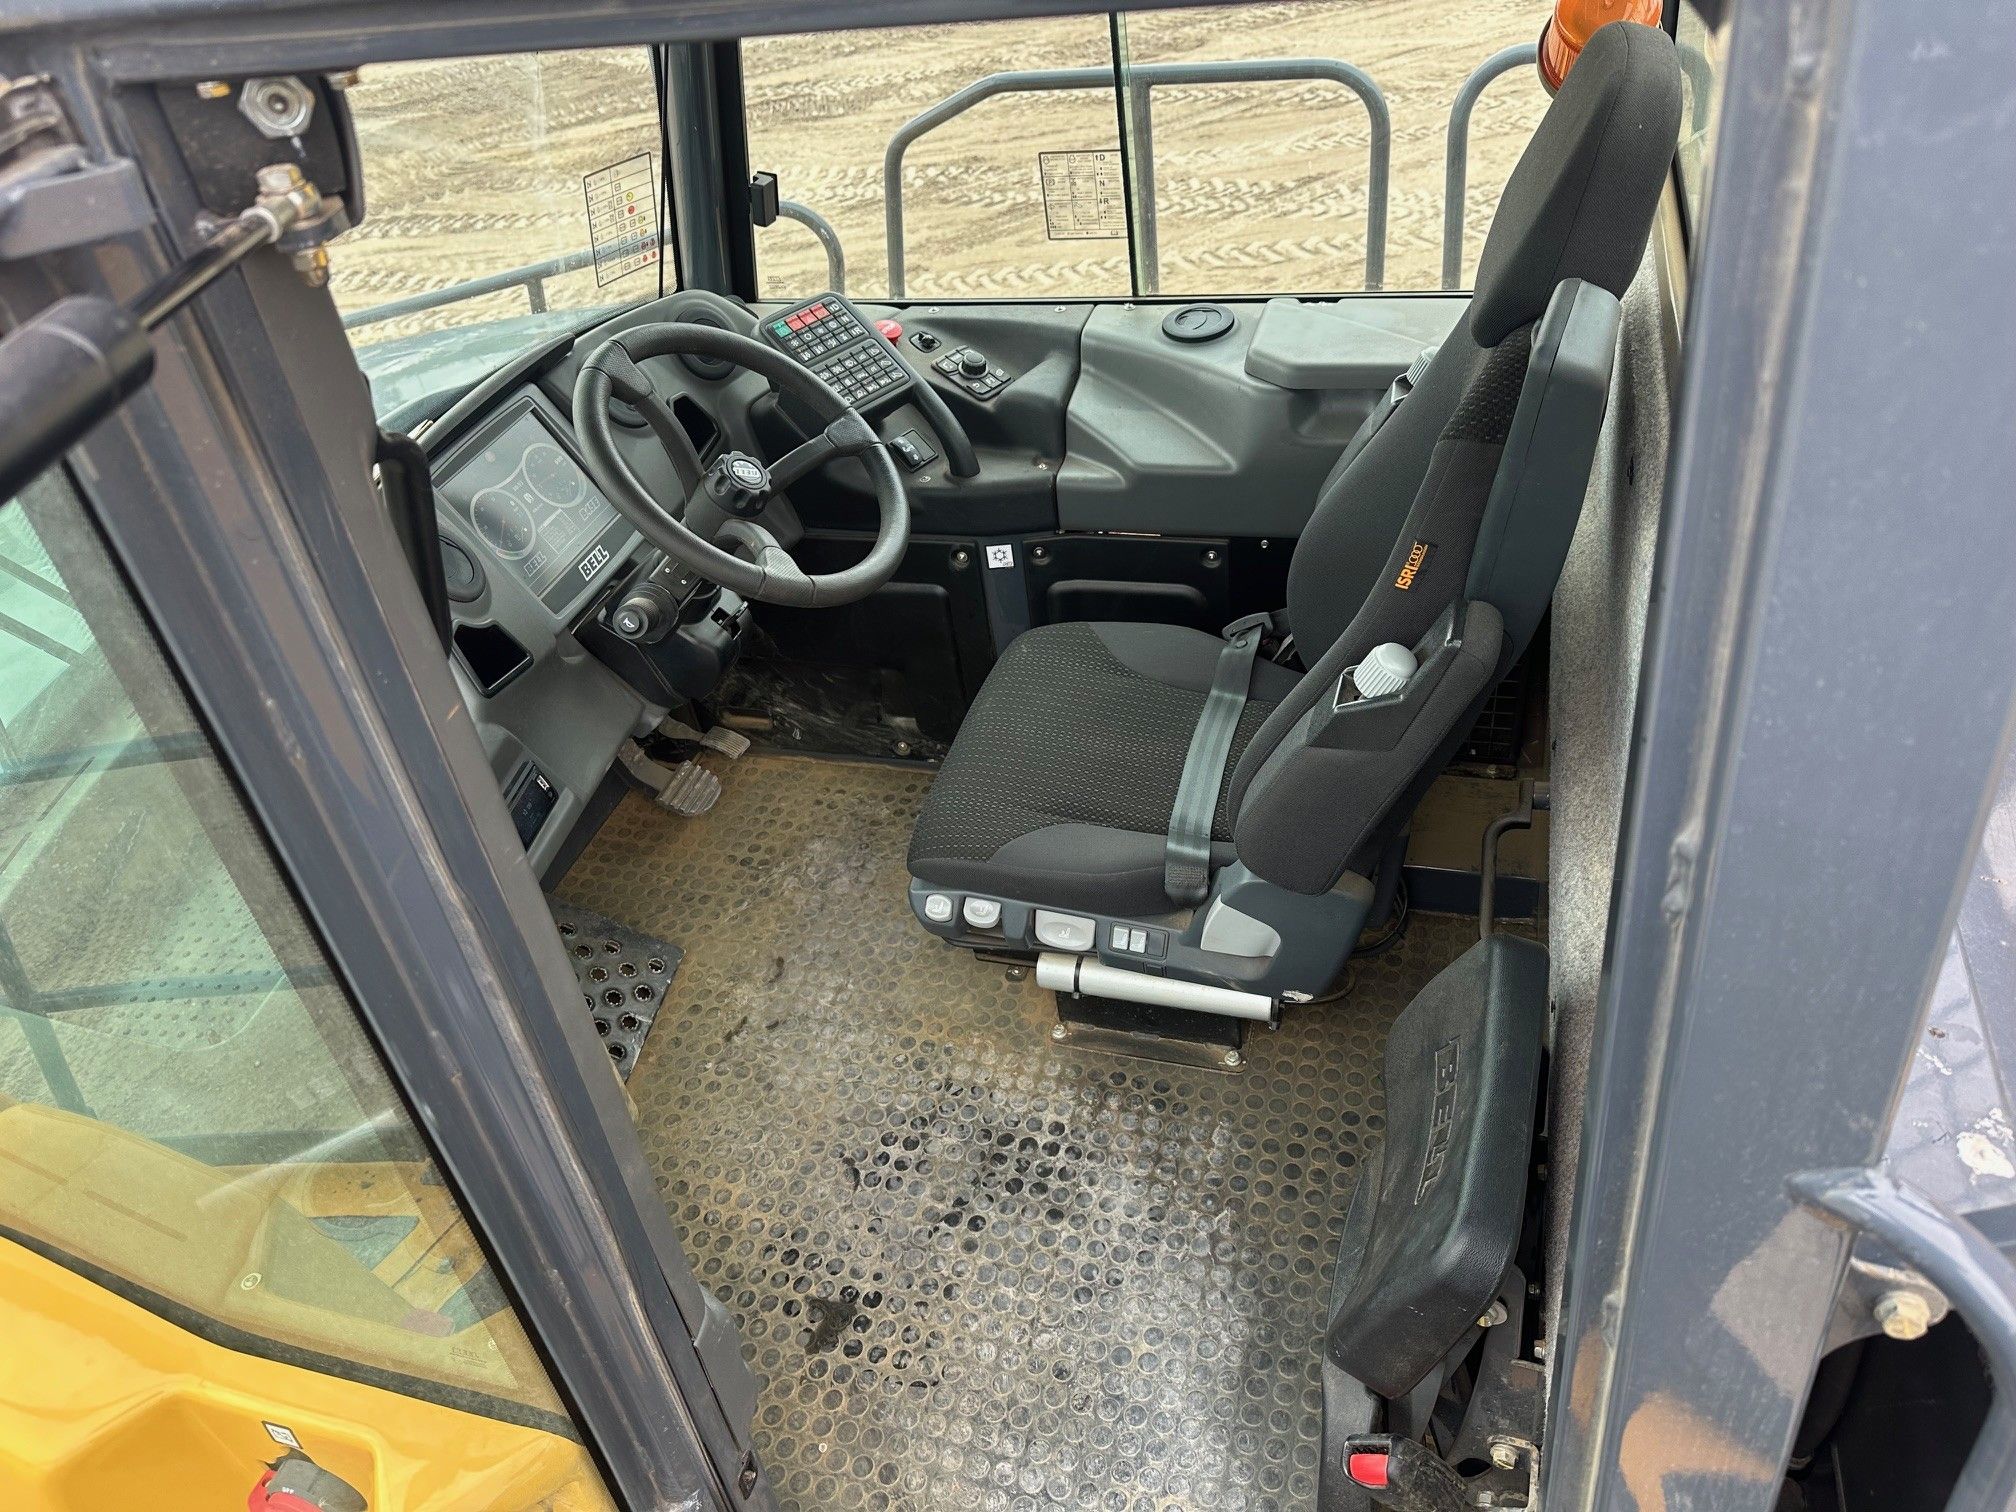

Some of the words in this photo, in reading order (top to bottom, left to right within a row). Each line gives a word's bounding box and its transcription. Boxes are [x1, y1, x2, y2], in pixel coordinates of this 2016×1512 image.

[1099, 153, 1106, 161] D
[1103, 197, 1110, 205] R
[579, 545, 609, 580] BELL
[1394, 561, 1419, 590] ISRI
[1415, 1035, 1461, 1205] BELL
